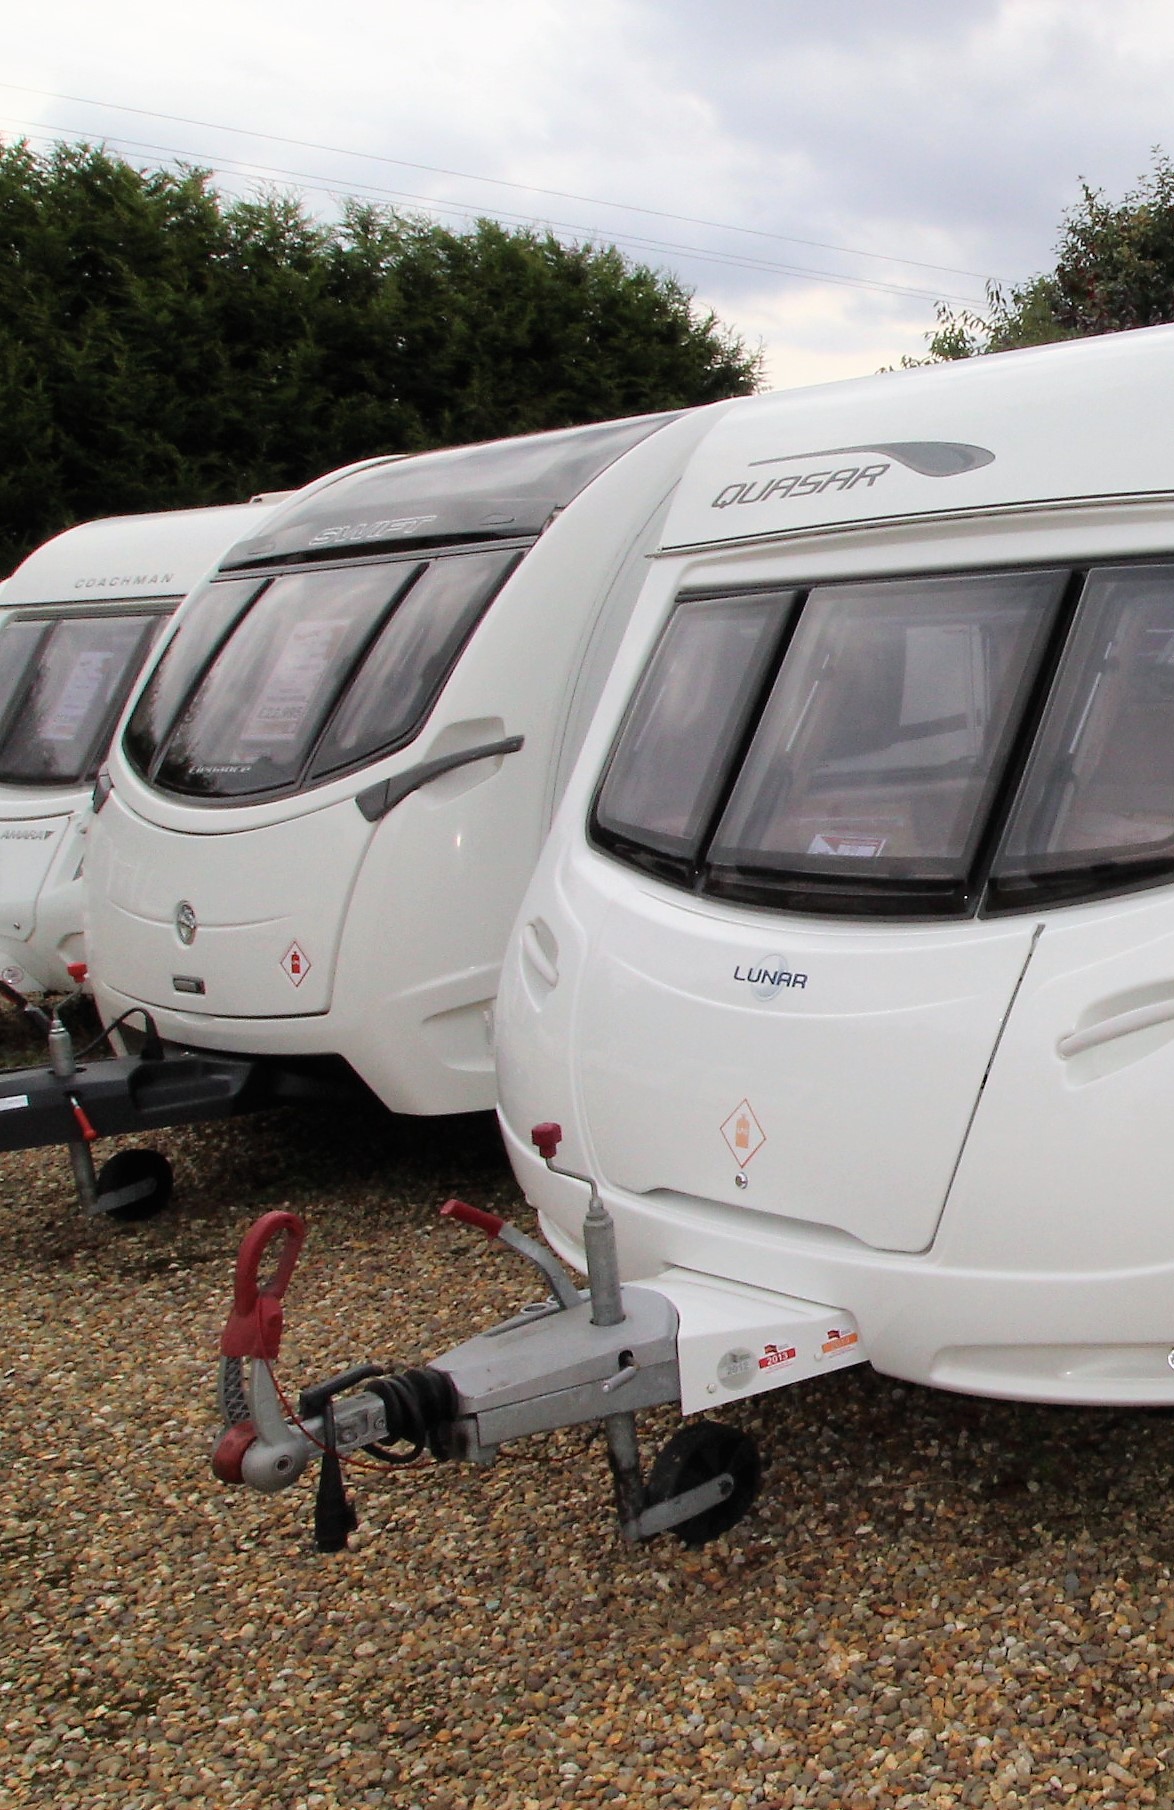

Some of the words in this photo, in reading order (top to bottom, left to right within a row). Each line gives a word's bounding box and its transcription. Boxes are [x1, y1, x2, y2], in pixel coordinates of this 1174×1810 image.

[711, 463, 891, 509] QUASAR
[308, 514, 438, 546] SWIFT
[74, 573, 174, 589] COACHMAN
[733, 965, 808, 987] LUNAR
[766, 1351, 789, 1366] 2013
